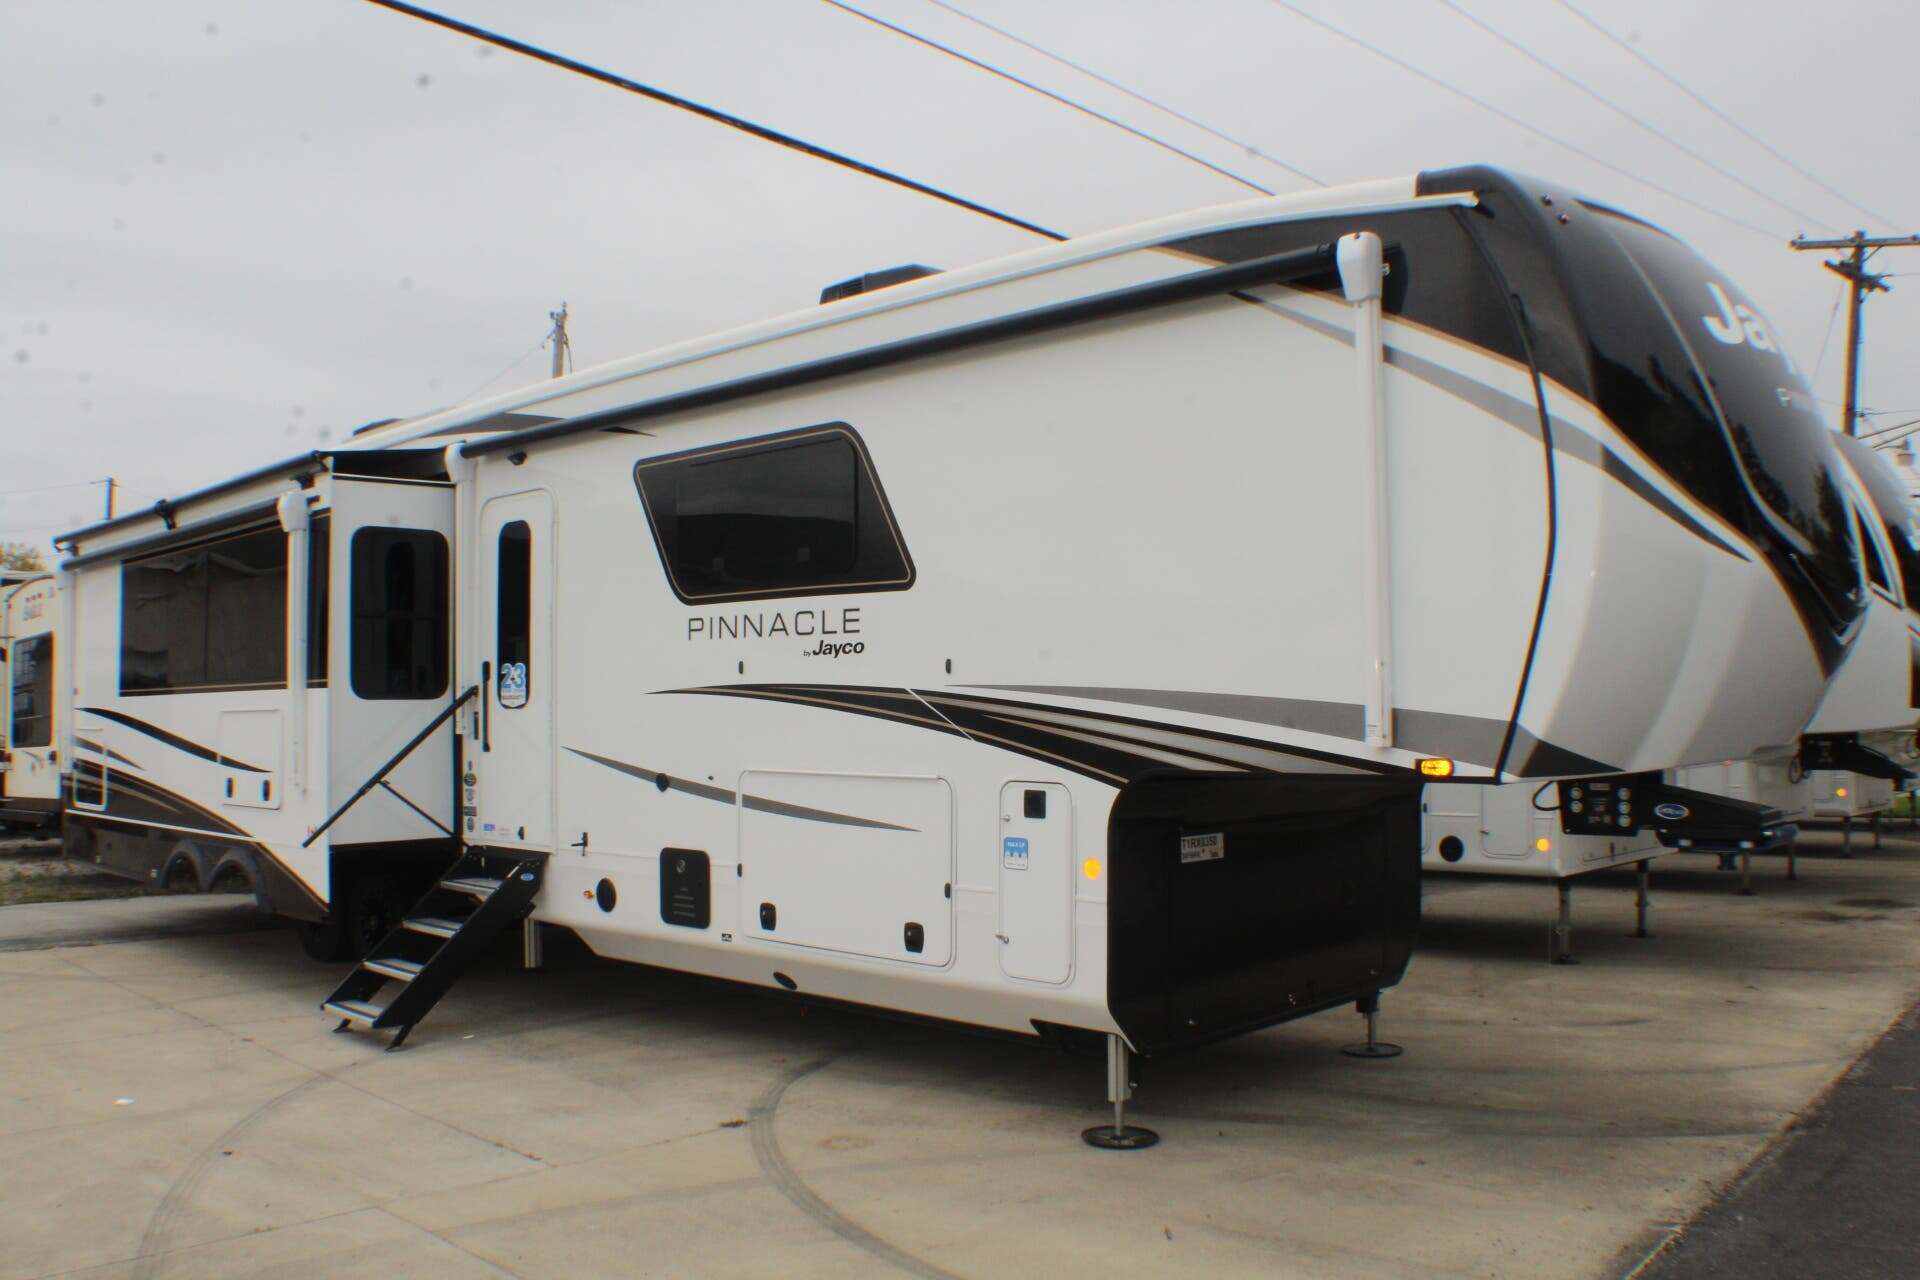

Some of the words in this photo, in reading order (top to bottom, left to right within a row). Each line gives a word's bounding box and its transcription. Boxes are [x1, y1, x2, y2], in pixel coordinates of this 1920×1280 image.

[1702, 282, 1786, 366] Ja
[688, 608, 862, 641] PINNACLE
[812, 640, 865, 659] Jayco
